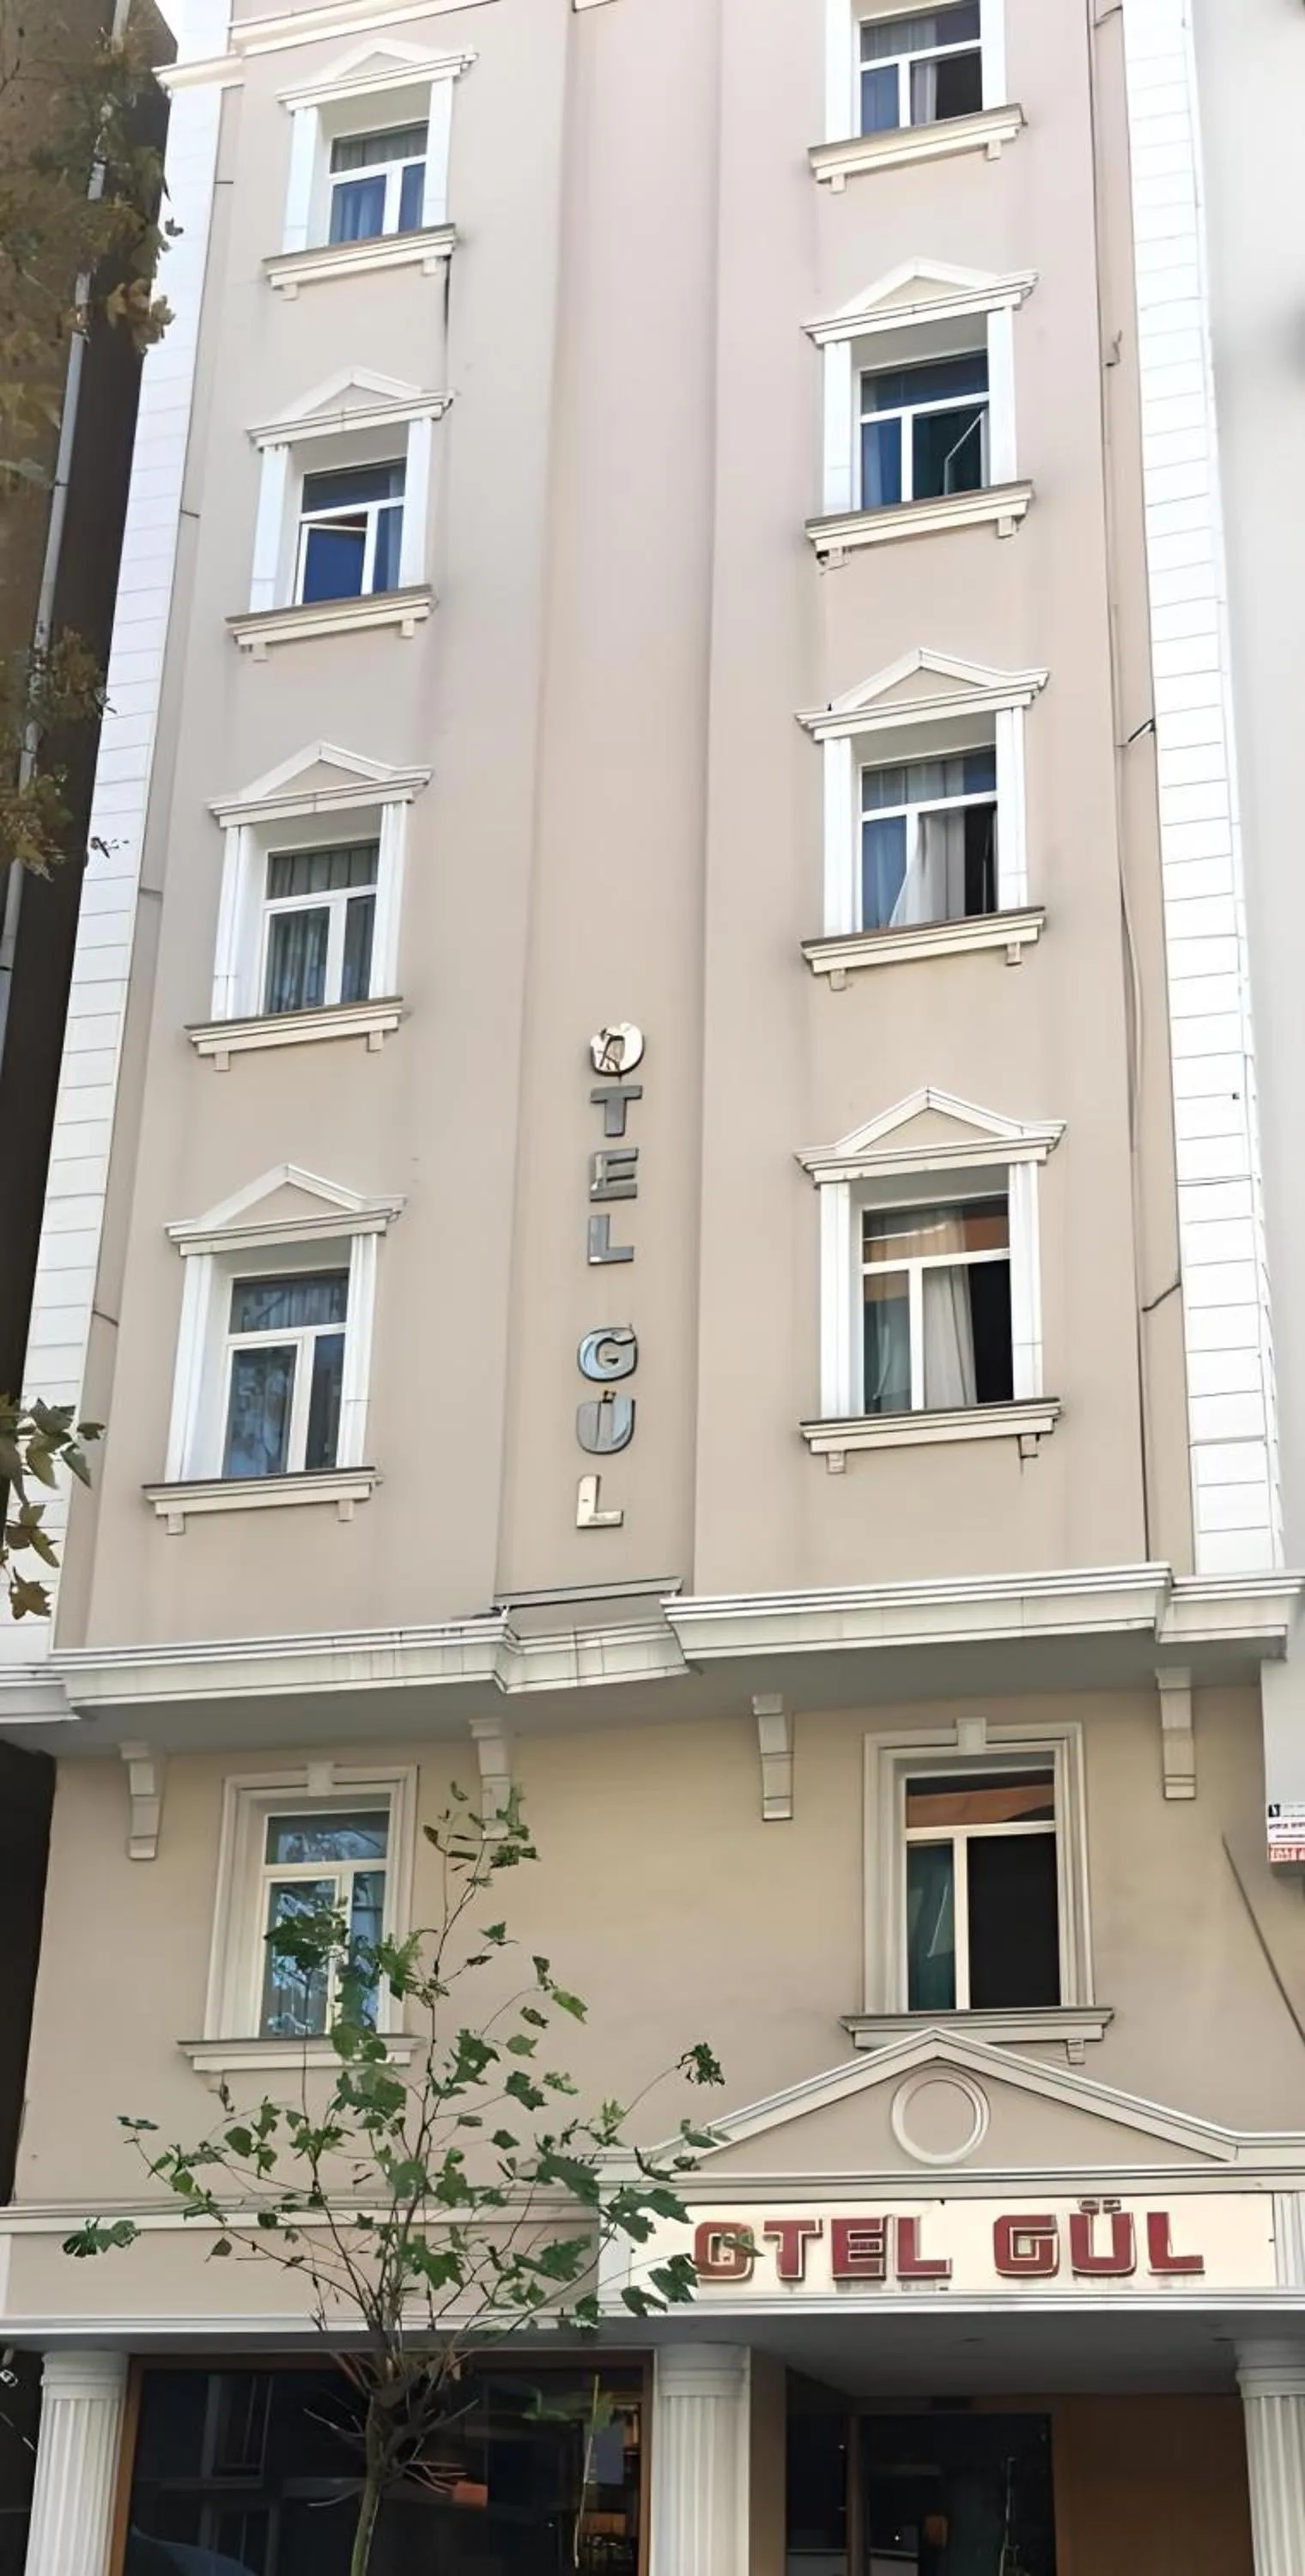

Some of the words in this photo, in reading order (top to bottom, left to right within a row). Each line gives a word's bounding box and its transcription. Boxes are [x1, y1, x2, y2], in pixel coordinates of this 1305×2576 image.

[588, 1021, 645, 1266] OTEL
[576, 1326, 638, 1528] GÜL
[694, 2215, 952, 2281] OTEL
[993, 2198, 1206, 2278] GÜL
